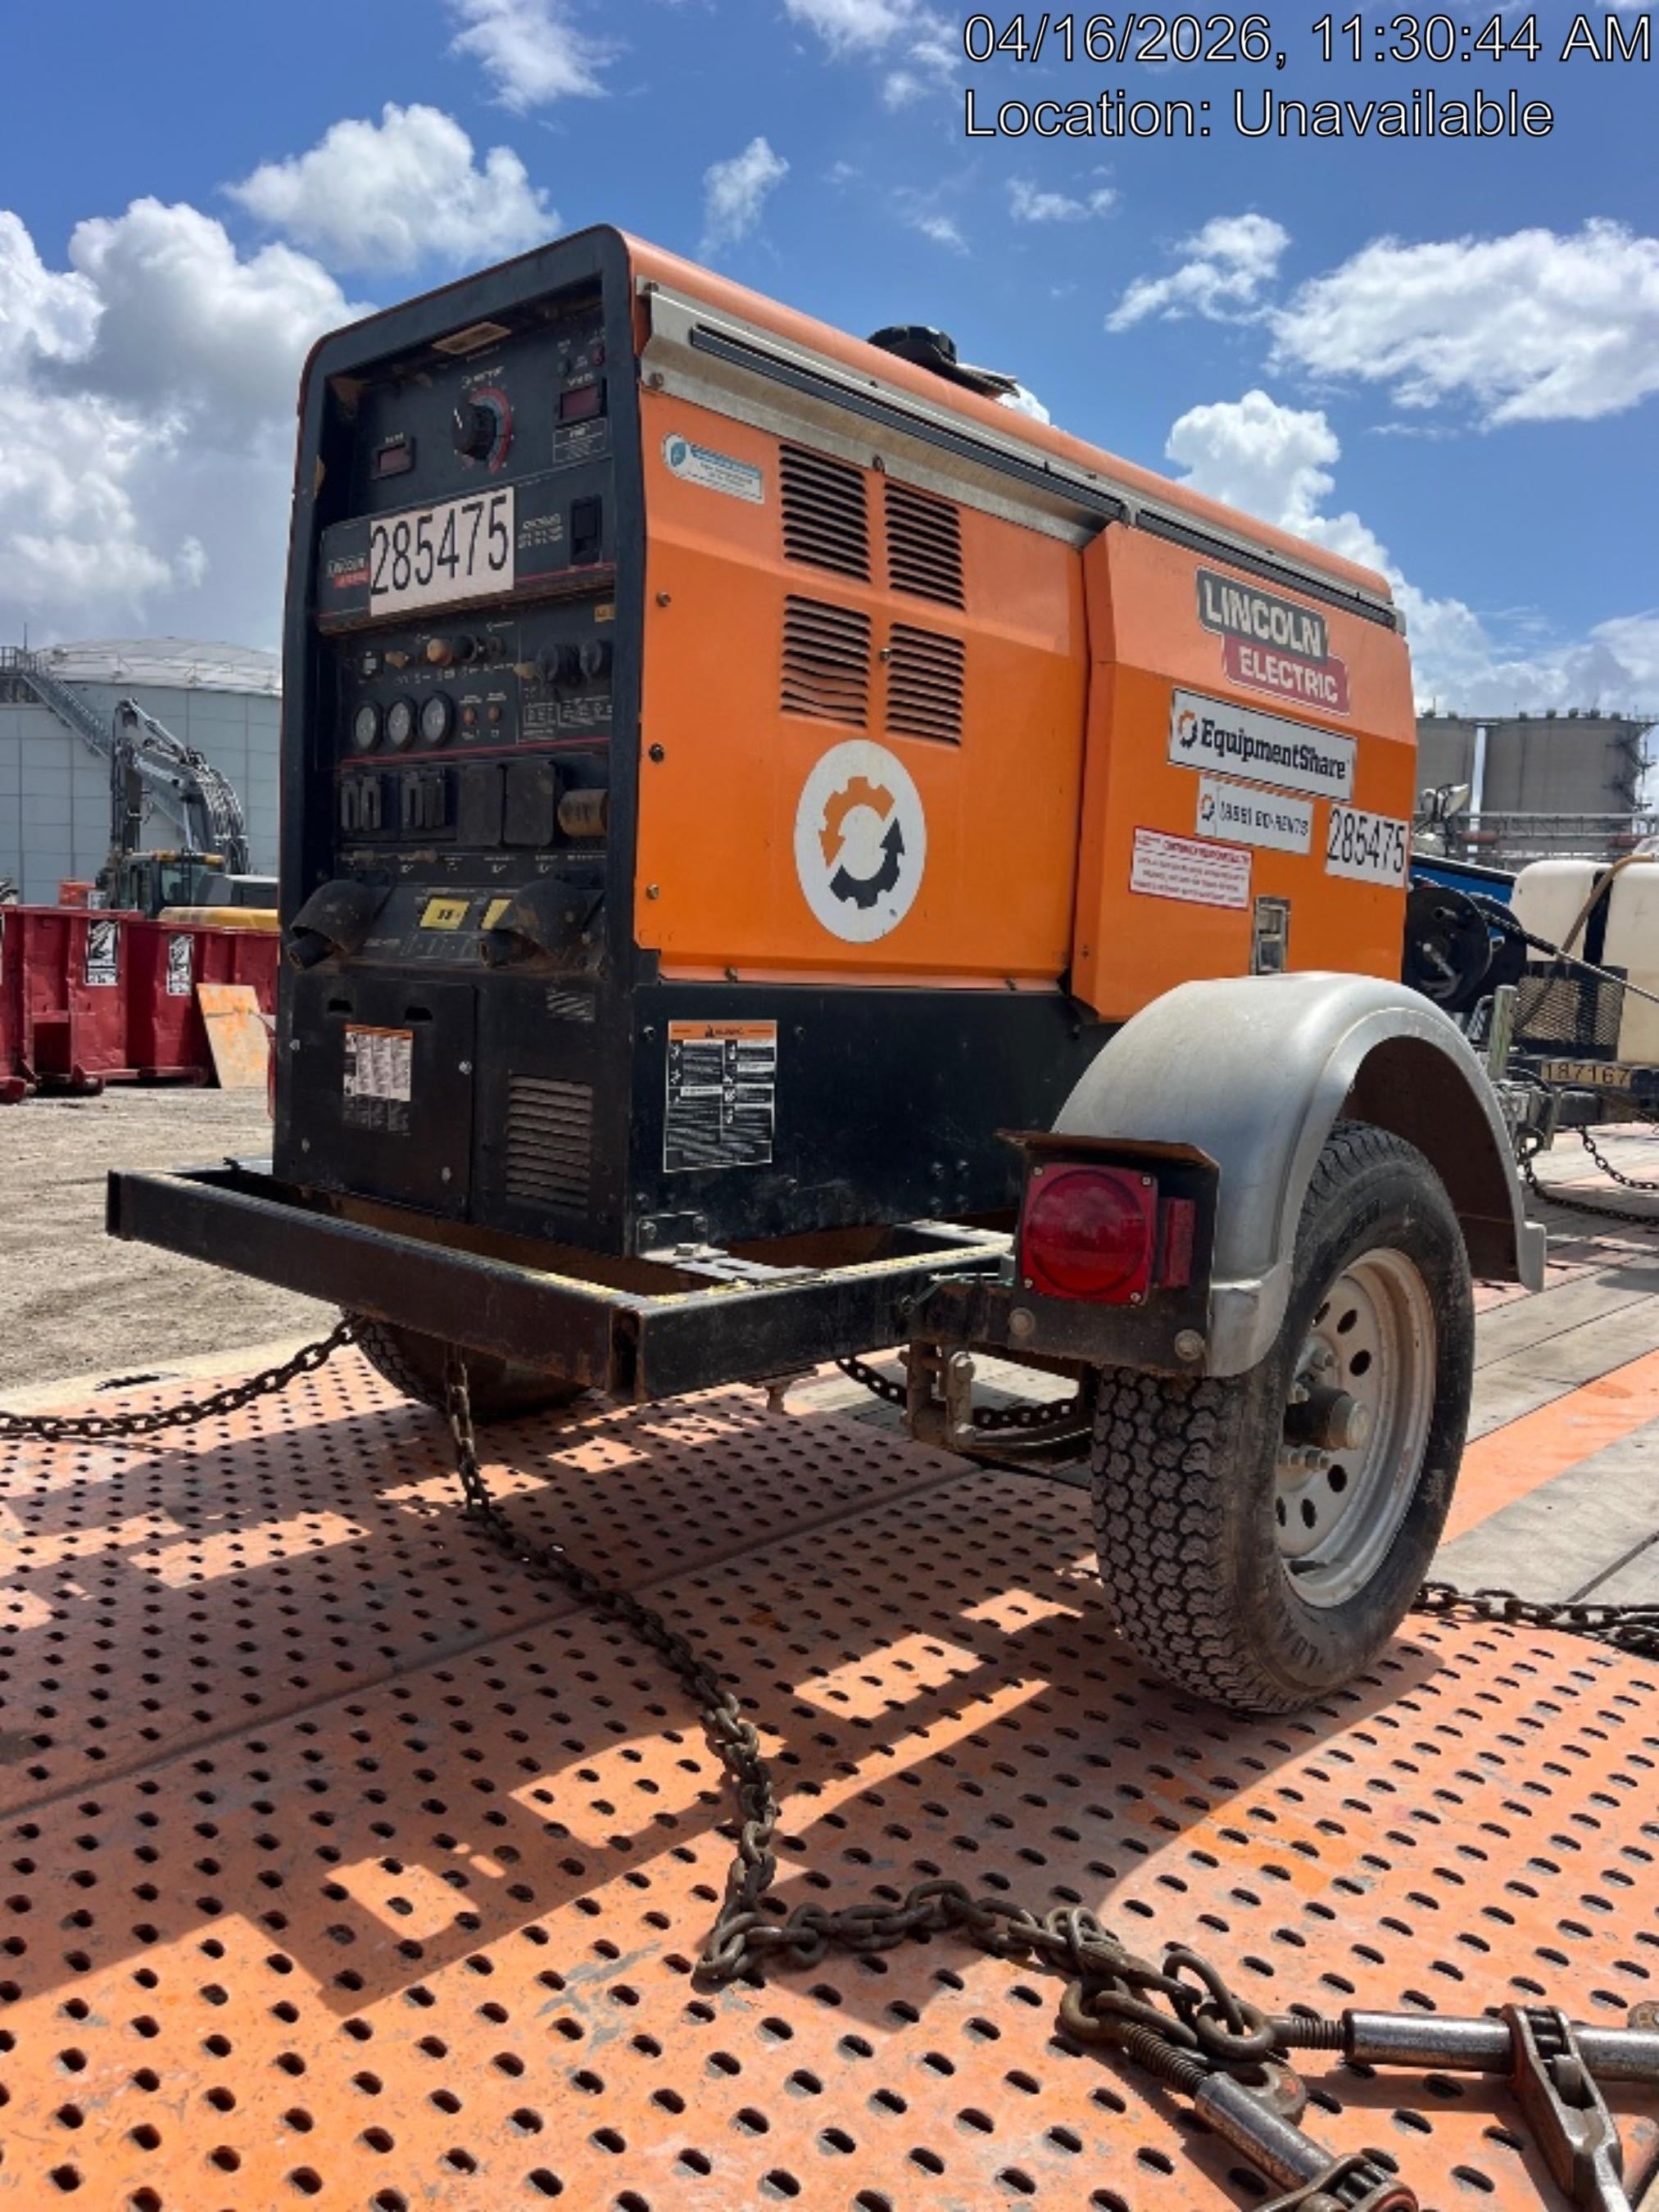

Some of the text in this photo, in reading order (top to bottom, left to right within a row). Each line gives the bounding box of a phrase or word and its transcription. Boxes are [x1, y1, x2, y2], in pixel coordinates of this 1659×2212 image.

[371, 495, 508, 596] 285475
[1204, 580, 1321, 657] LINCOLN
[1239, 646, 1337, 703] ELECTRIC
[1201, 718, 1346, 779] EquipmentShare
[1327, 808, 1405, 873] 285475
[1547, 1062, 1630, 1085] 187167
